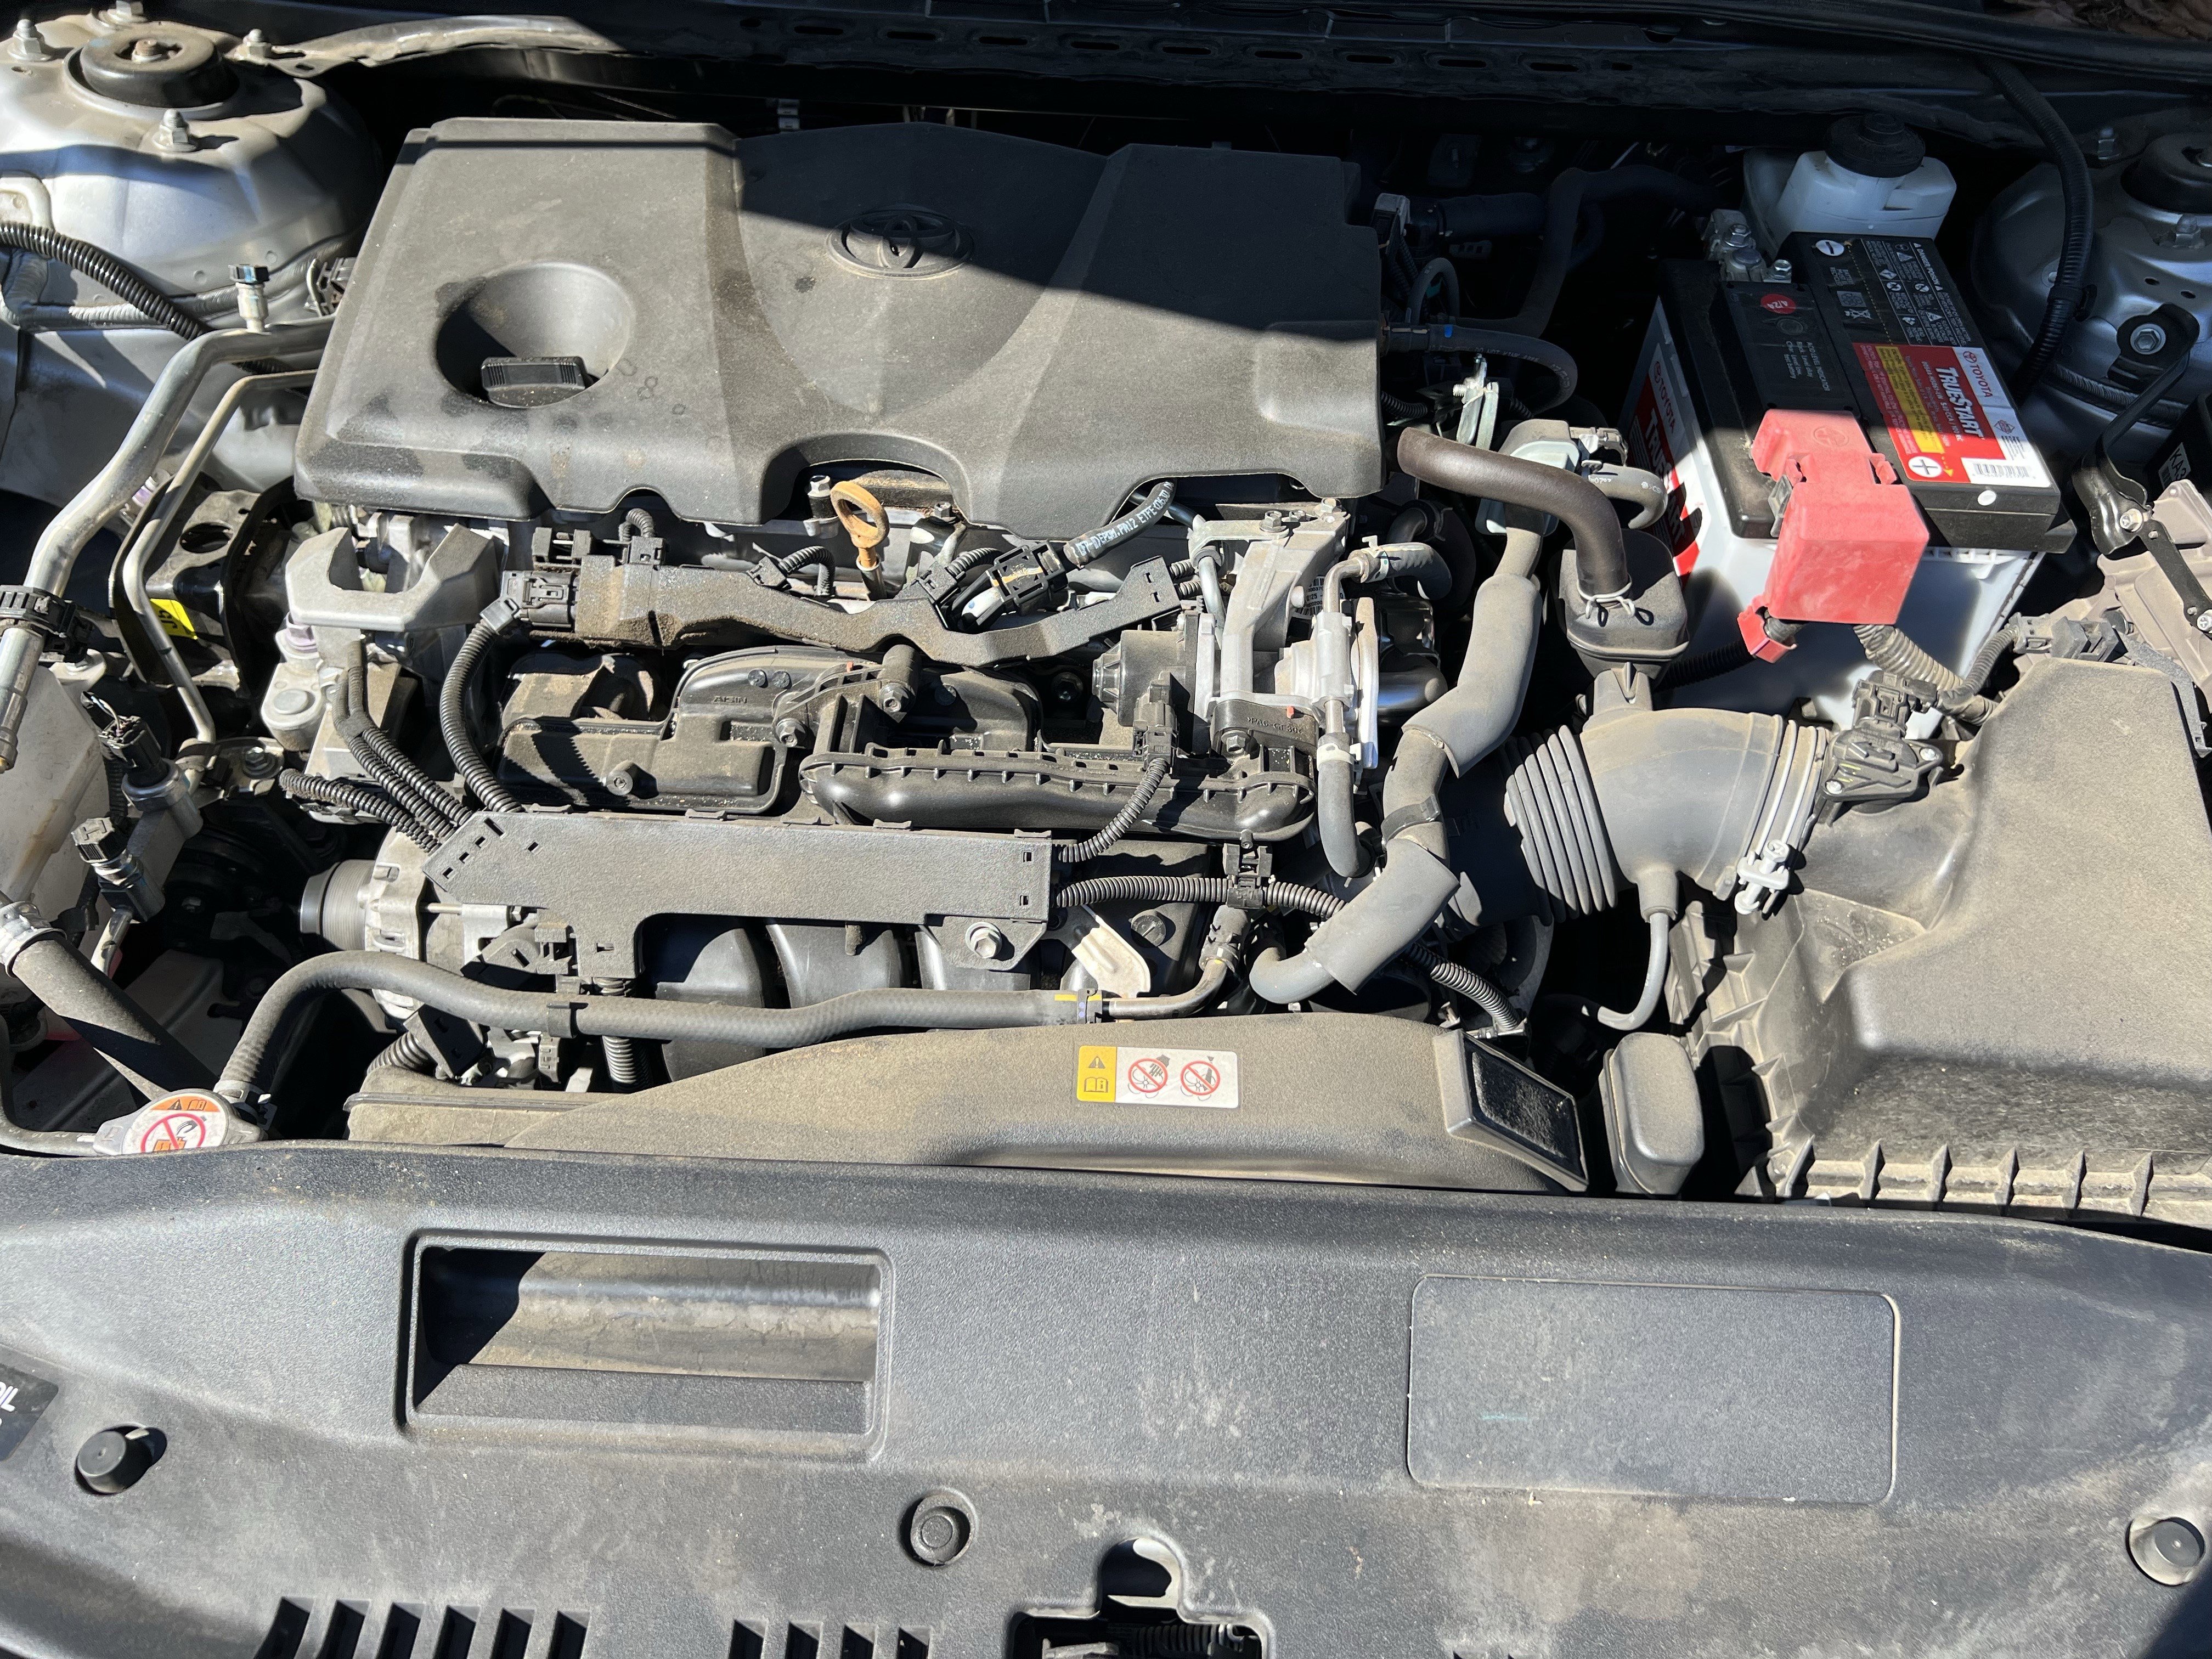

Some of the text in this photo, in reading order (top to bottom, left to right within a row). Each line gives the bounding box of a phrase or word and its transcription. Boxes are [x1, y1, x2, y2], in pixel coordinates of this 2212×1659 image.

[1916, 249, 1940, 285] DANGER POISON
[1767, 300, 1788, 309] 4/24
[1970, 365, 1993, 398] TOYOTA
[1659, 382, 1677, 433] TOYOTA
[1936, 367, 1985, 439] TRUESTART
[712, 695, 748, 704] AISIN
